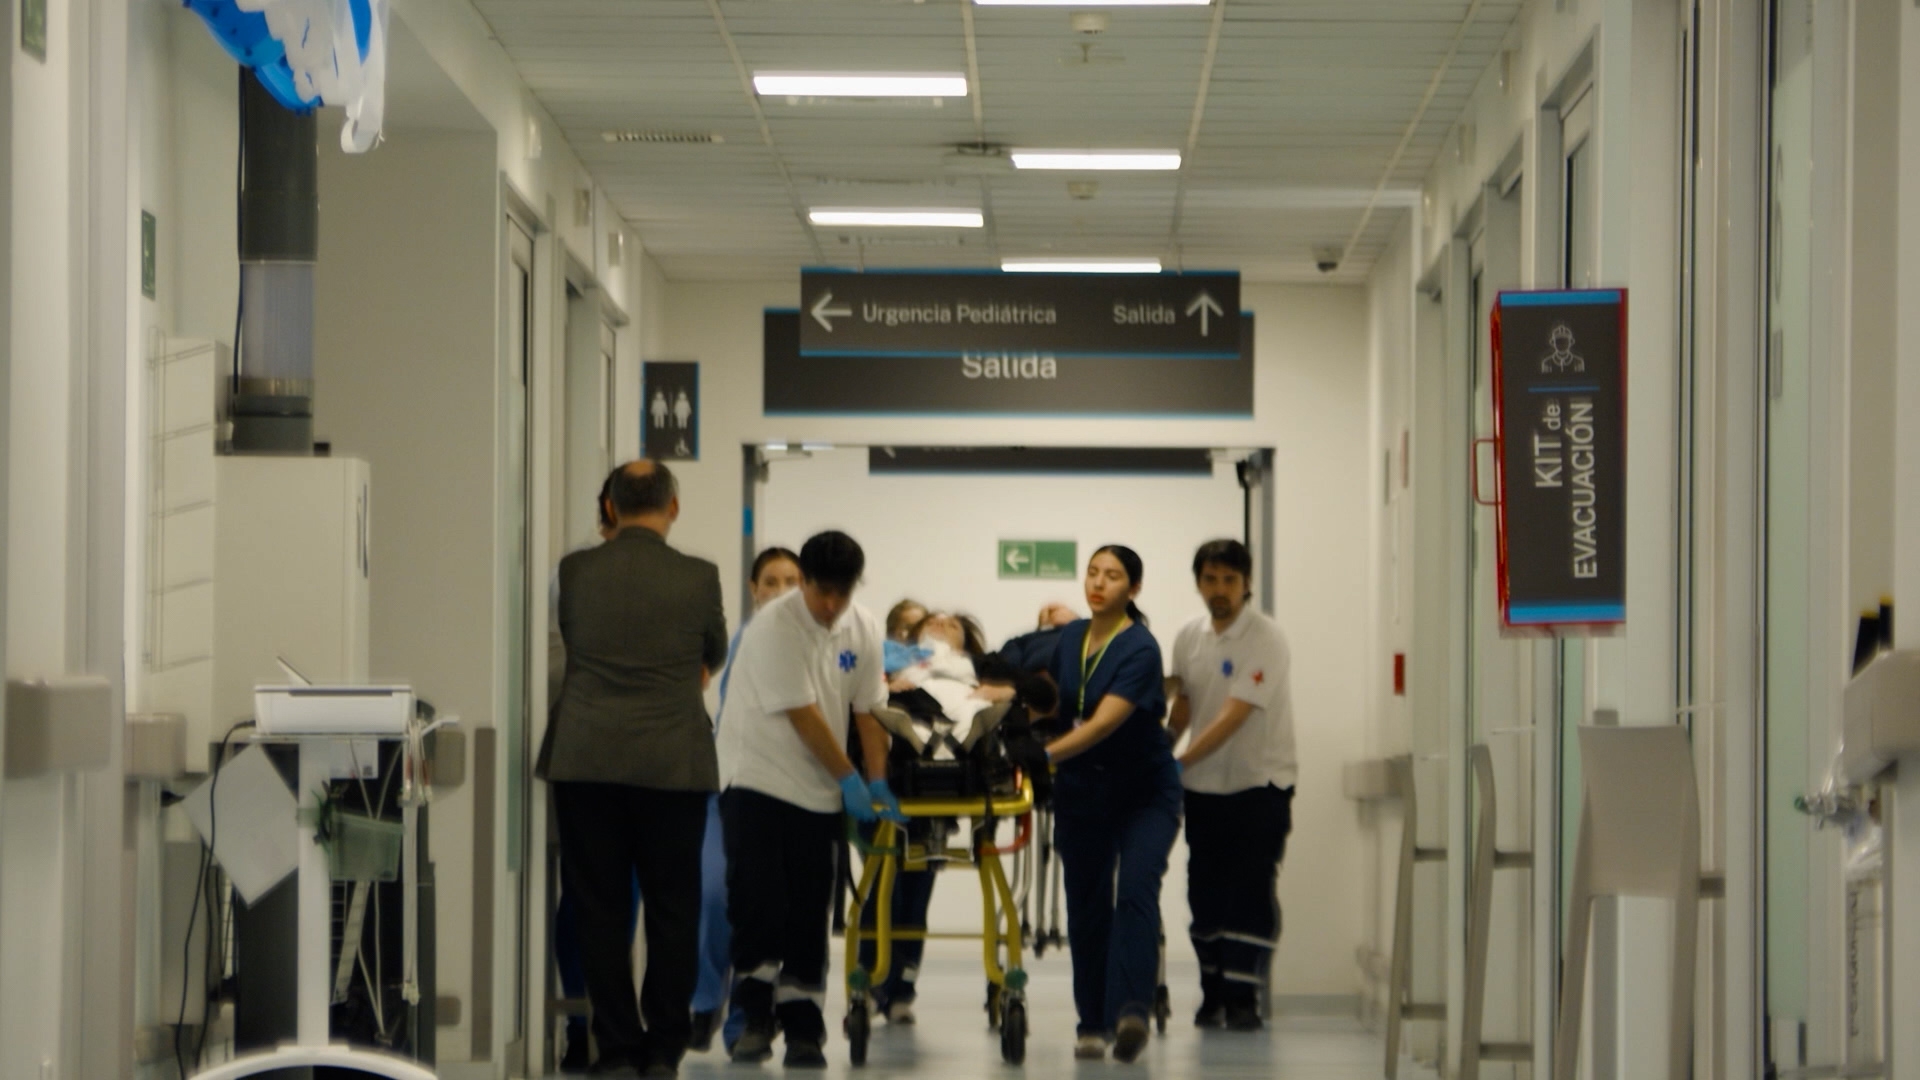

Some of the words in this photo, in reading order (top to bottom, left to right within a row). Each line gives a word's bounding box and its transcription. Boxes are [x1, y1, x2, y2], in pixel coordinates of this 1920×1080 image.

[862, 303, 951, 327] Urgencia
[956, 303, 1057, 324] Pediátrica
[1113, 303, 1176, 325] Salida
[961, 353, 1057, 379] Salida
[1542, 403, 1562, 431] de
[1534, 434, 1563, 488] KIT
[1566, 402, 1598, 579] EVACUACIÓN
